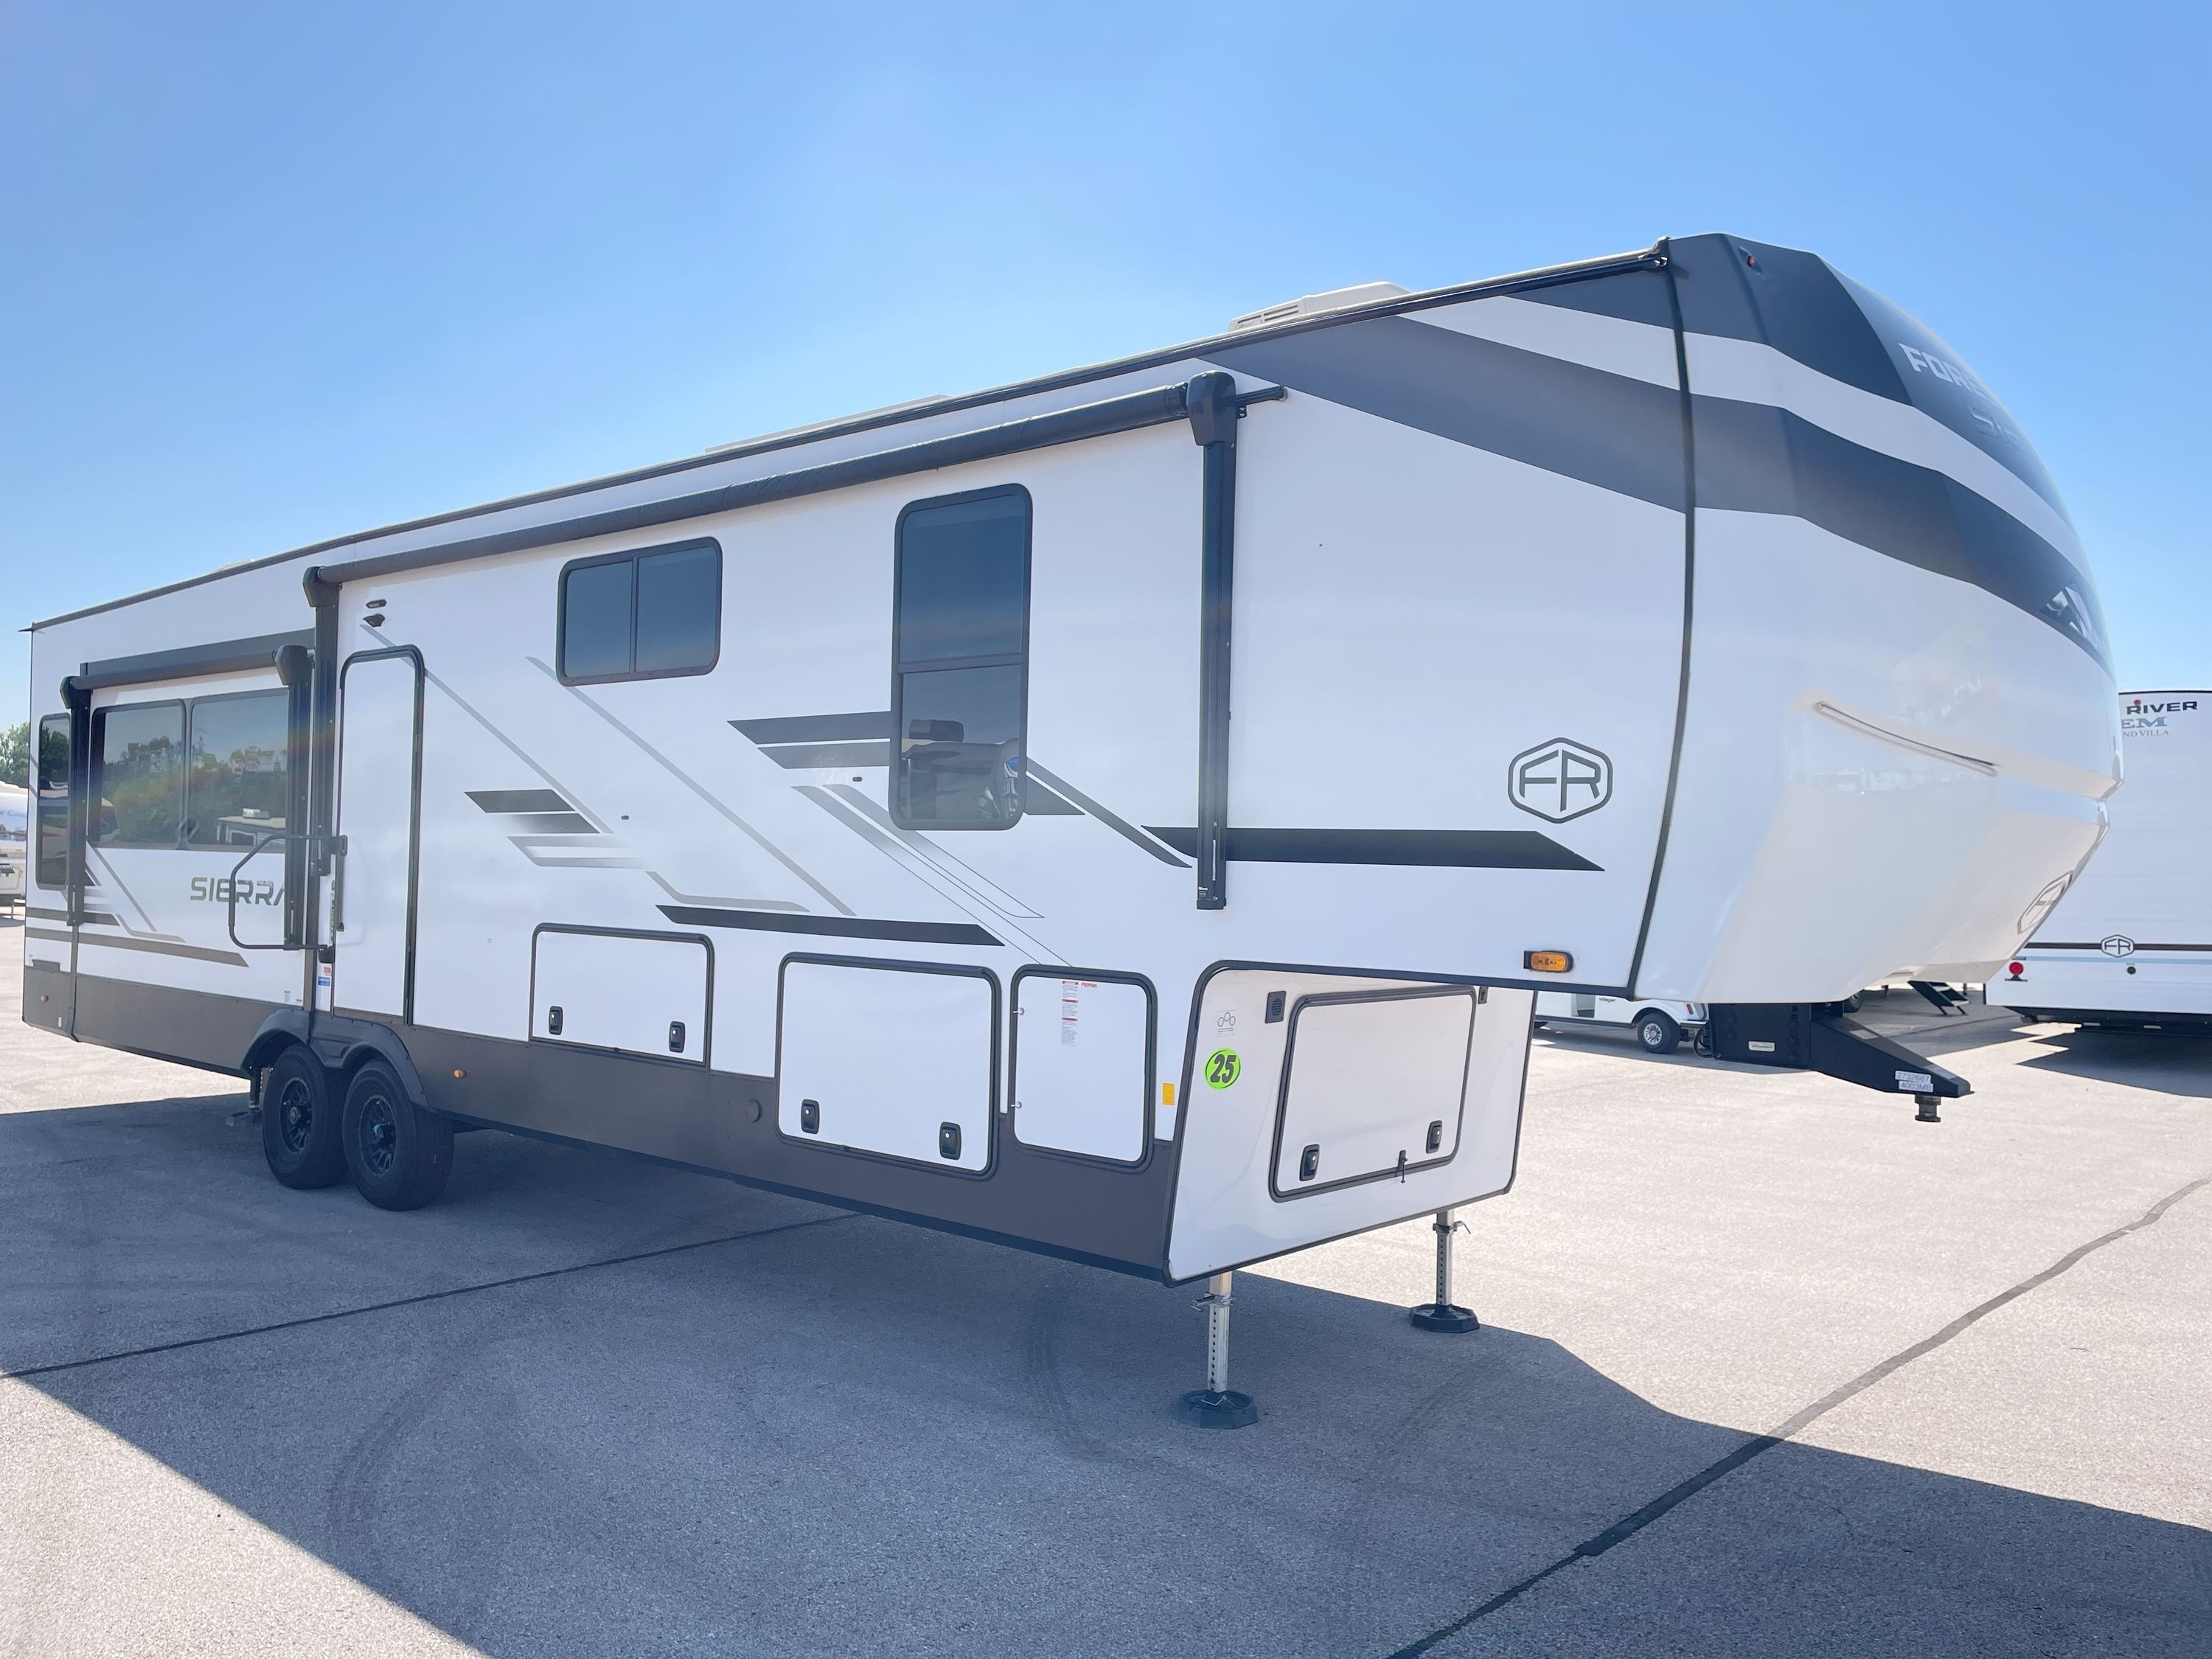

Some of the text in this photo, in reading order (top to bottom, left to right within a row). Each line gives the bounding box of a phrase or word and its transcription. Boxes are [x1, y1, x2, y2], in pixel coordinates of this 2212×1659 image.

[1898, 342, 1995, 403] FORE
[2126, 700, 2198, 715] RIVER
[2121, 716, 2167, 729] EM
[2139, 729, 2169, 737] VILLA
[1519, 748, 1601, 812] FR
[2104, 937, 2132, 955] FR
[1210, 1054, 1237, 1084] 25
